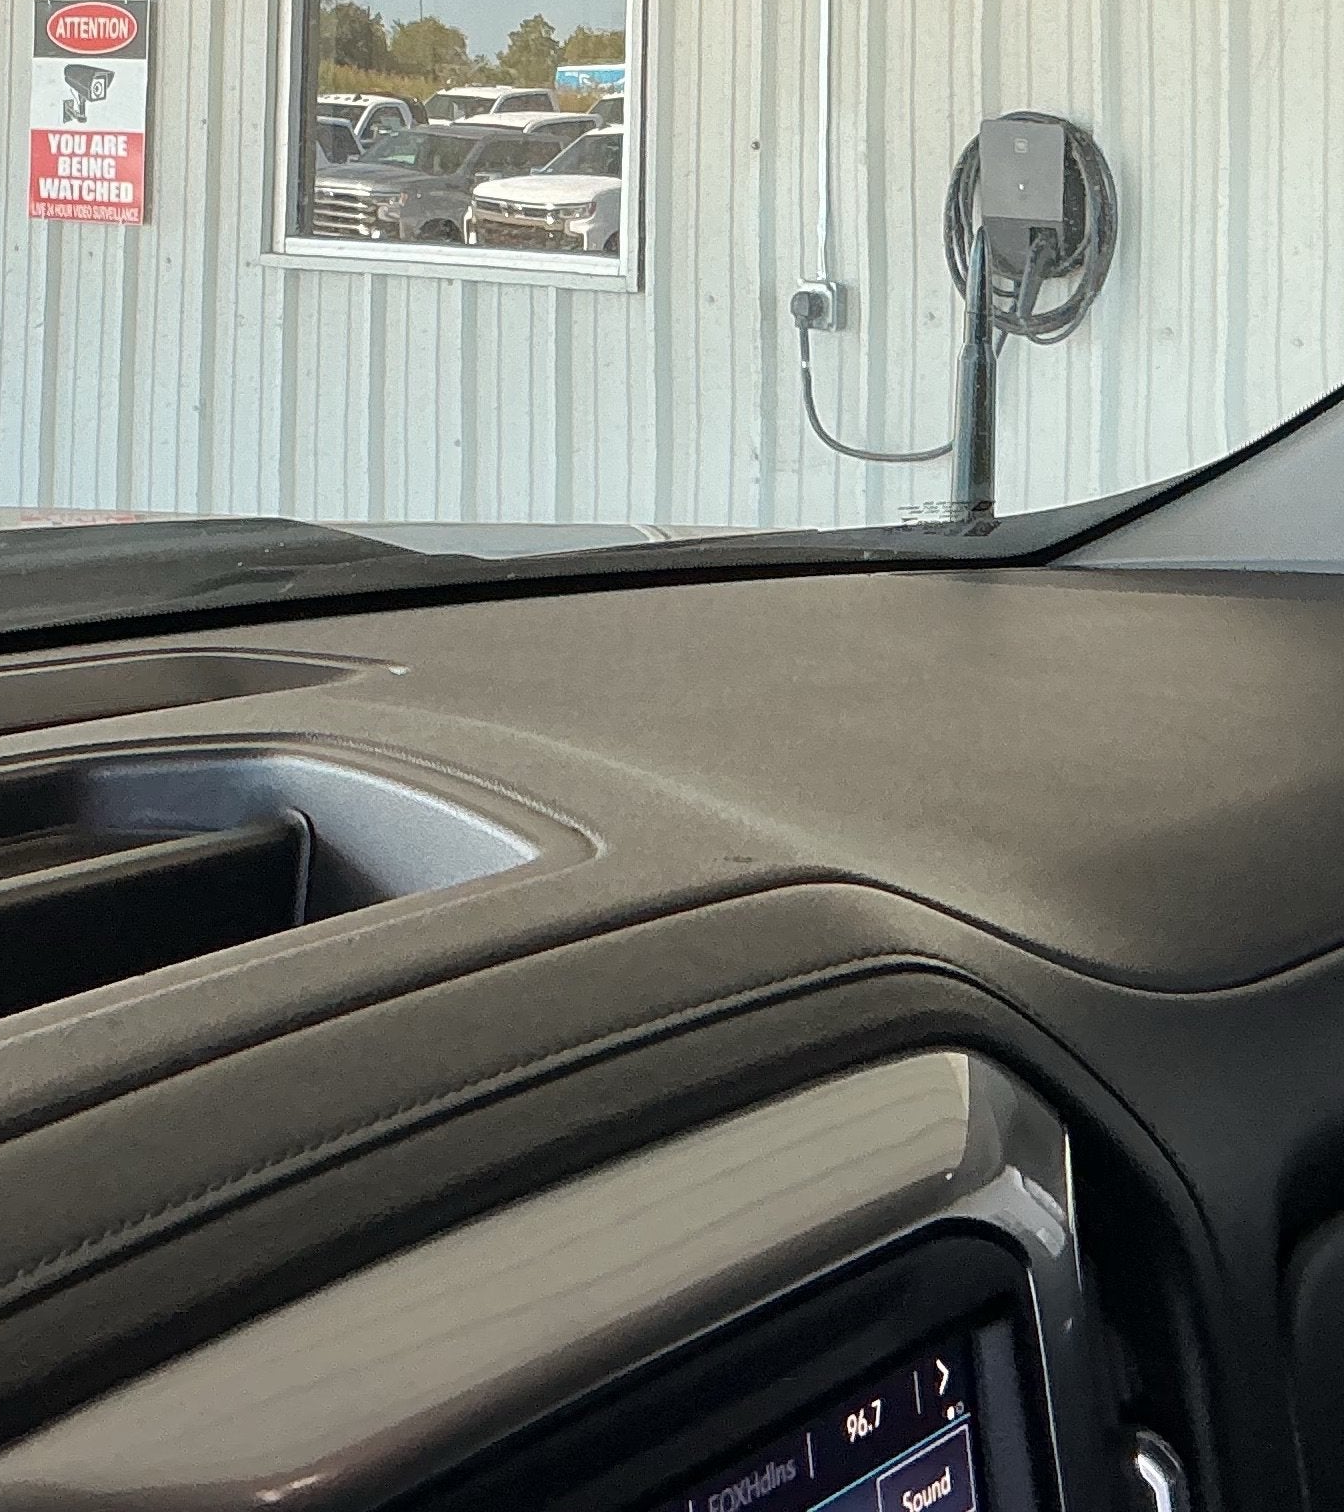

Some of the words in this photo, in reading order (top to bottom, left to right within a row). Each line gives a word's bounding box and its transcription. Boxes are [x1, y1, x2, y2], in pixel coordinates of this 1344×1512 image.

[56, 16, 129, 39] ATTENTION
[47, 133, 87, 155] YOU
[89, 135, 128, 157] ARE
[57, 156, 116, 179] BEING
[38, 177, 134, 204] WATCHED
[846, 1398, 882, 1443] 96.7
[901, 1465, 952, 1512] Sound
